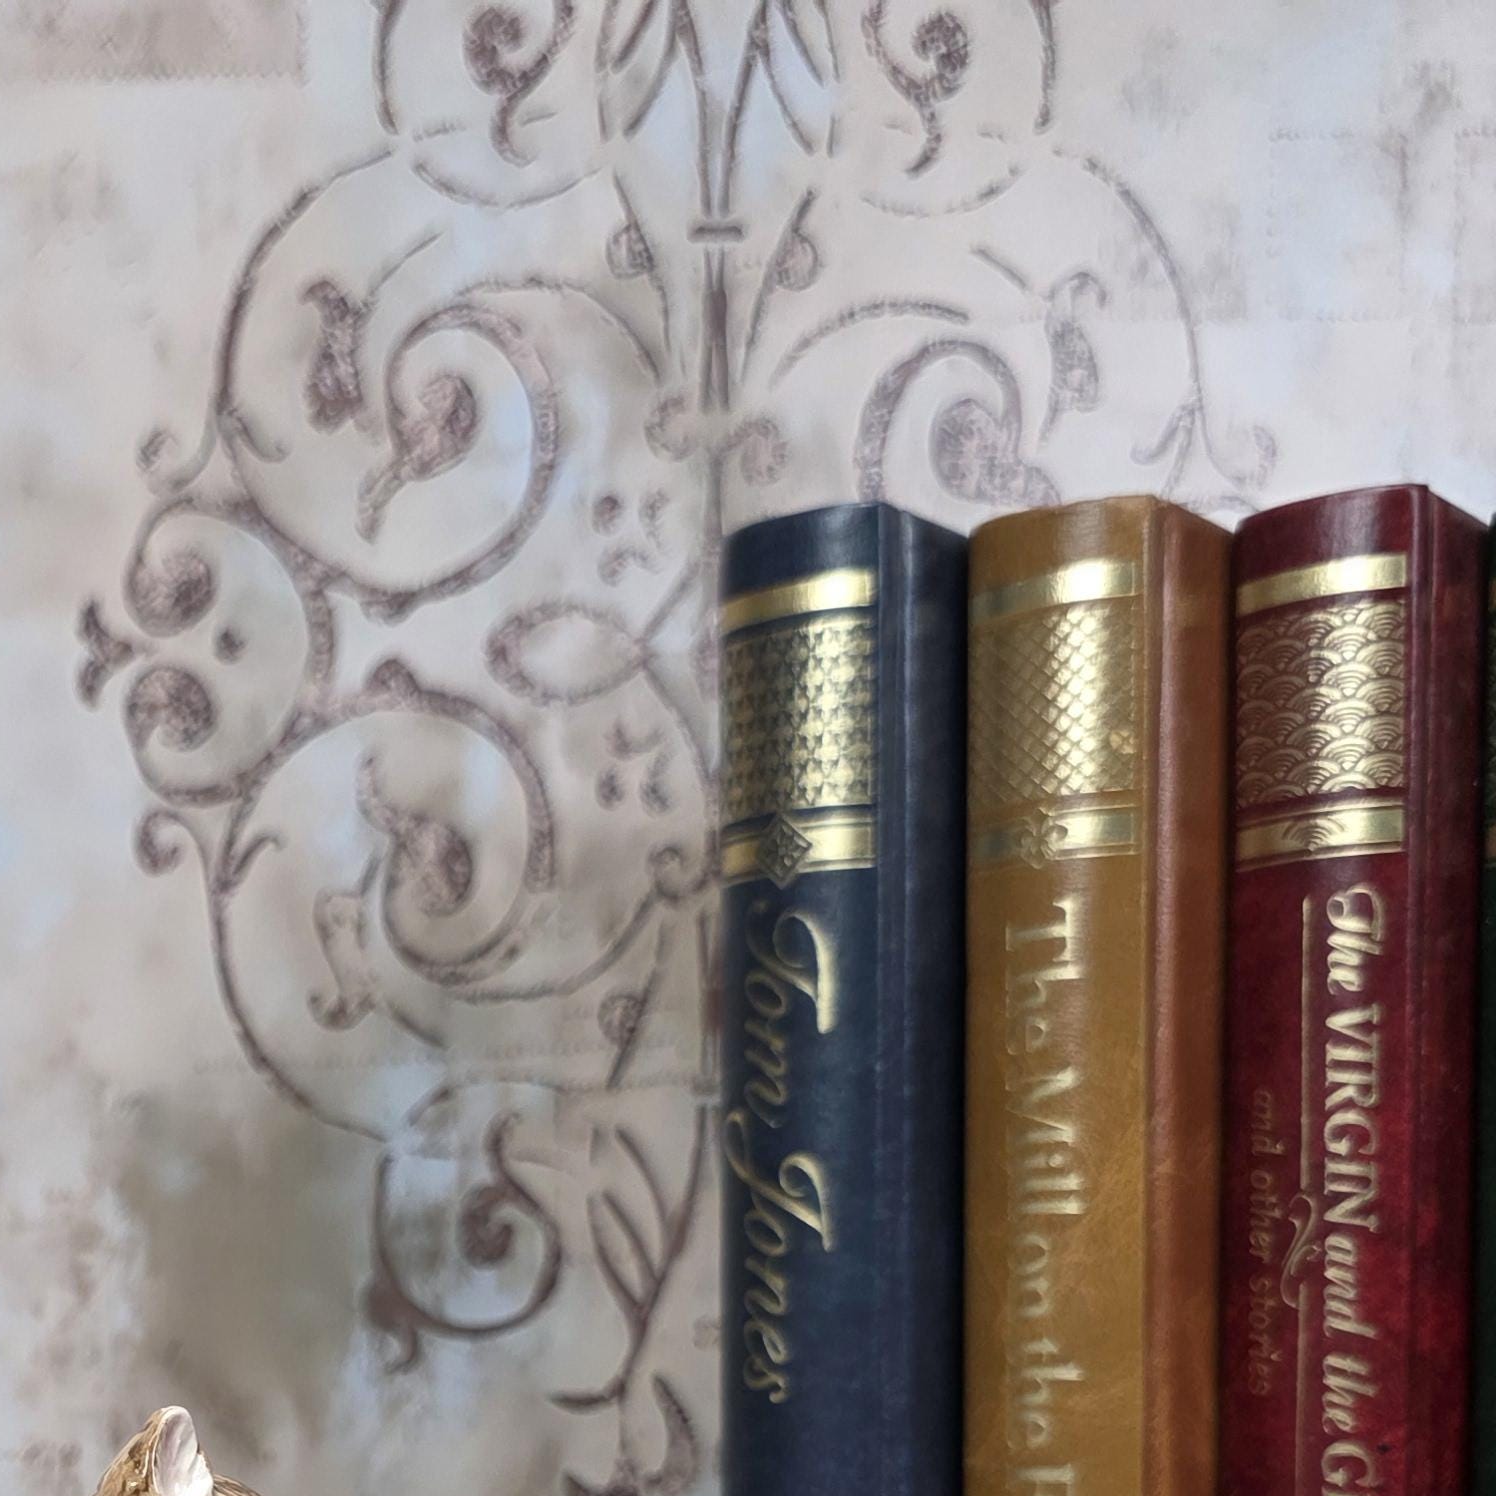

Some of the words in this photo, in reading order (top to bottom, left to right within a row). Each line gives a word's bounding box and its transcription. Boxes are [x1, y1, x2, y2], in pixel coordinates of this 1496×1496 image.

[1005, 897, 1084, 1056] The
[1324, 885, 1387, 995] The
[743, 899, 840, 1128] Tom
[1005, 1066, 1085, 1218] Mill
[1321, 1003, 1381, 1234] VIRGIN
[723, 1107, 835, 1405] Jones
[1247, 1169, 1284, 1264] other
[1005, 1233, 1058, 1319] on
[1321, 1237, 1375, 1339] and
[1005, 1337, 1084, 1450] the
[1246, 1276, 1282, 1398] stories
[1321, 1354, 1375, 1436] the
